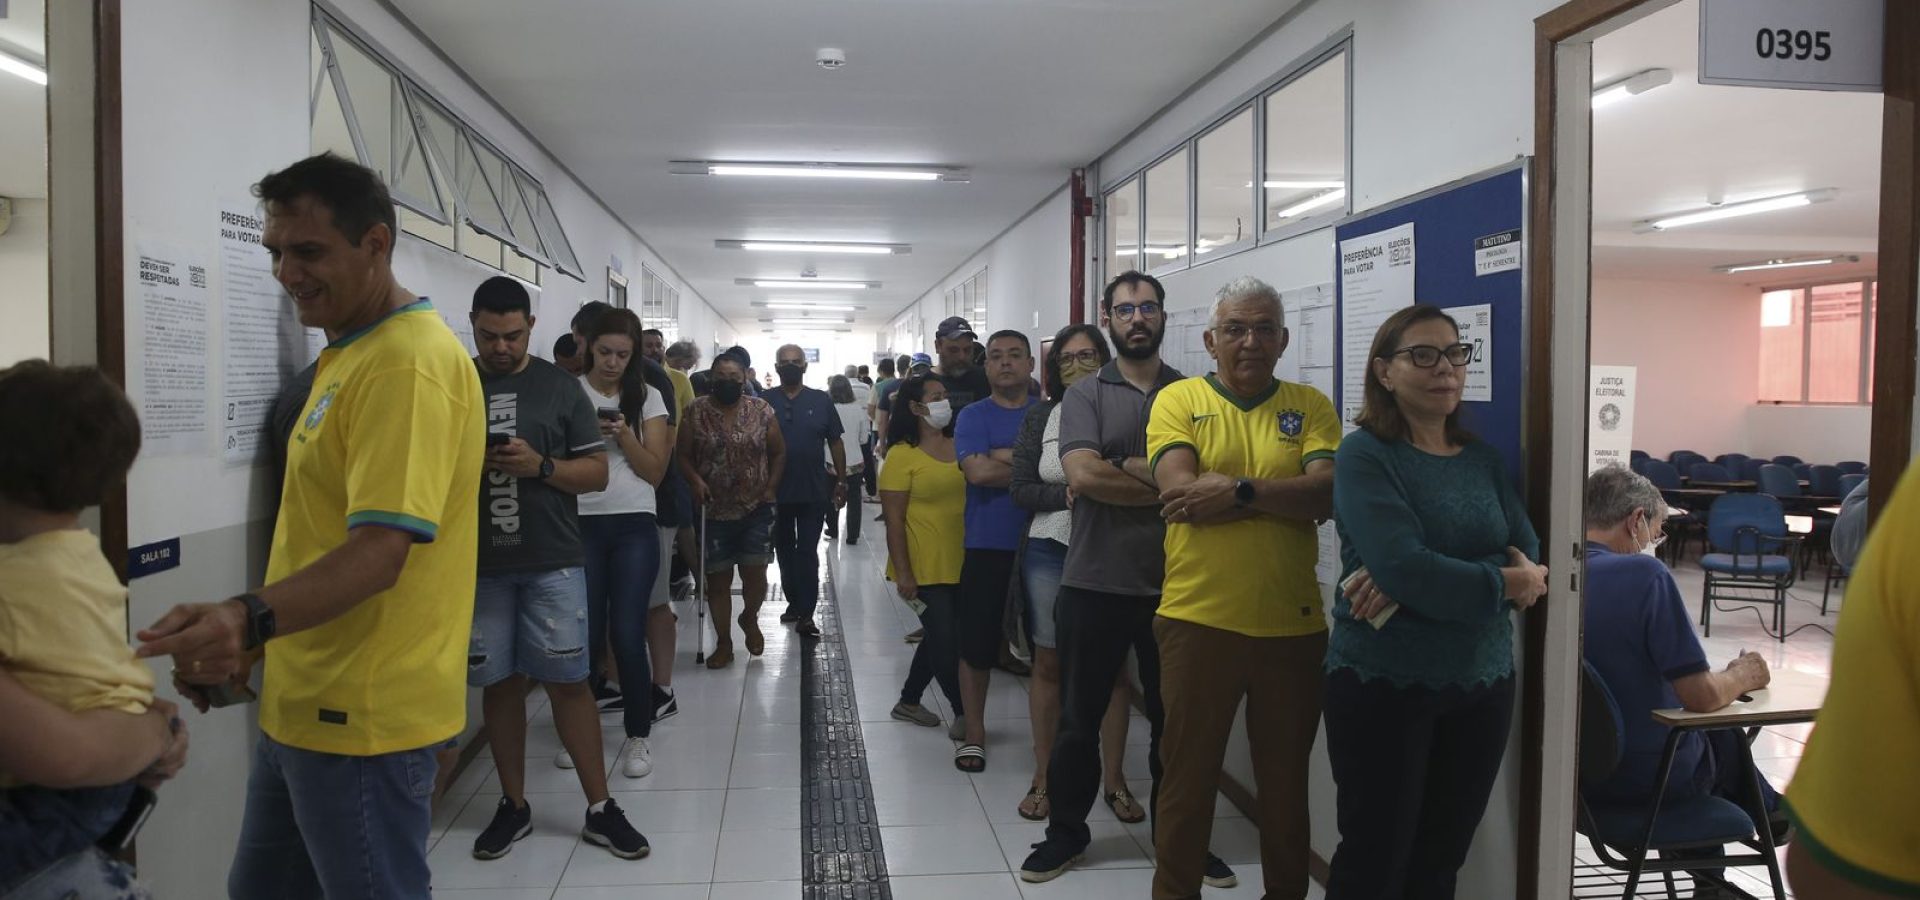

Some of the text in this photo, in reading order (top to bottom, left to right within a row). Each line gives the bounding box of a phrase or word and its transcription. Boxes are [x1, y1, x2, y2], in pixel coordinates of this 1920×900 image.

[1756, 28, 1831, 61] 0395
[221, 229, 261, 245] PARA VOTAR
[1344, 246, 1383, 264] PREFERÊNCIA
[1356, 262, 1374, 273] VOTAR
[1600, 377, 1624, 386] JUSTIÇA
[1596, 388, 1625, 397] ELEITORAL
[140, 551, 158, 564] SALA
